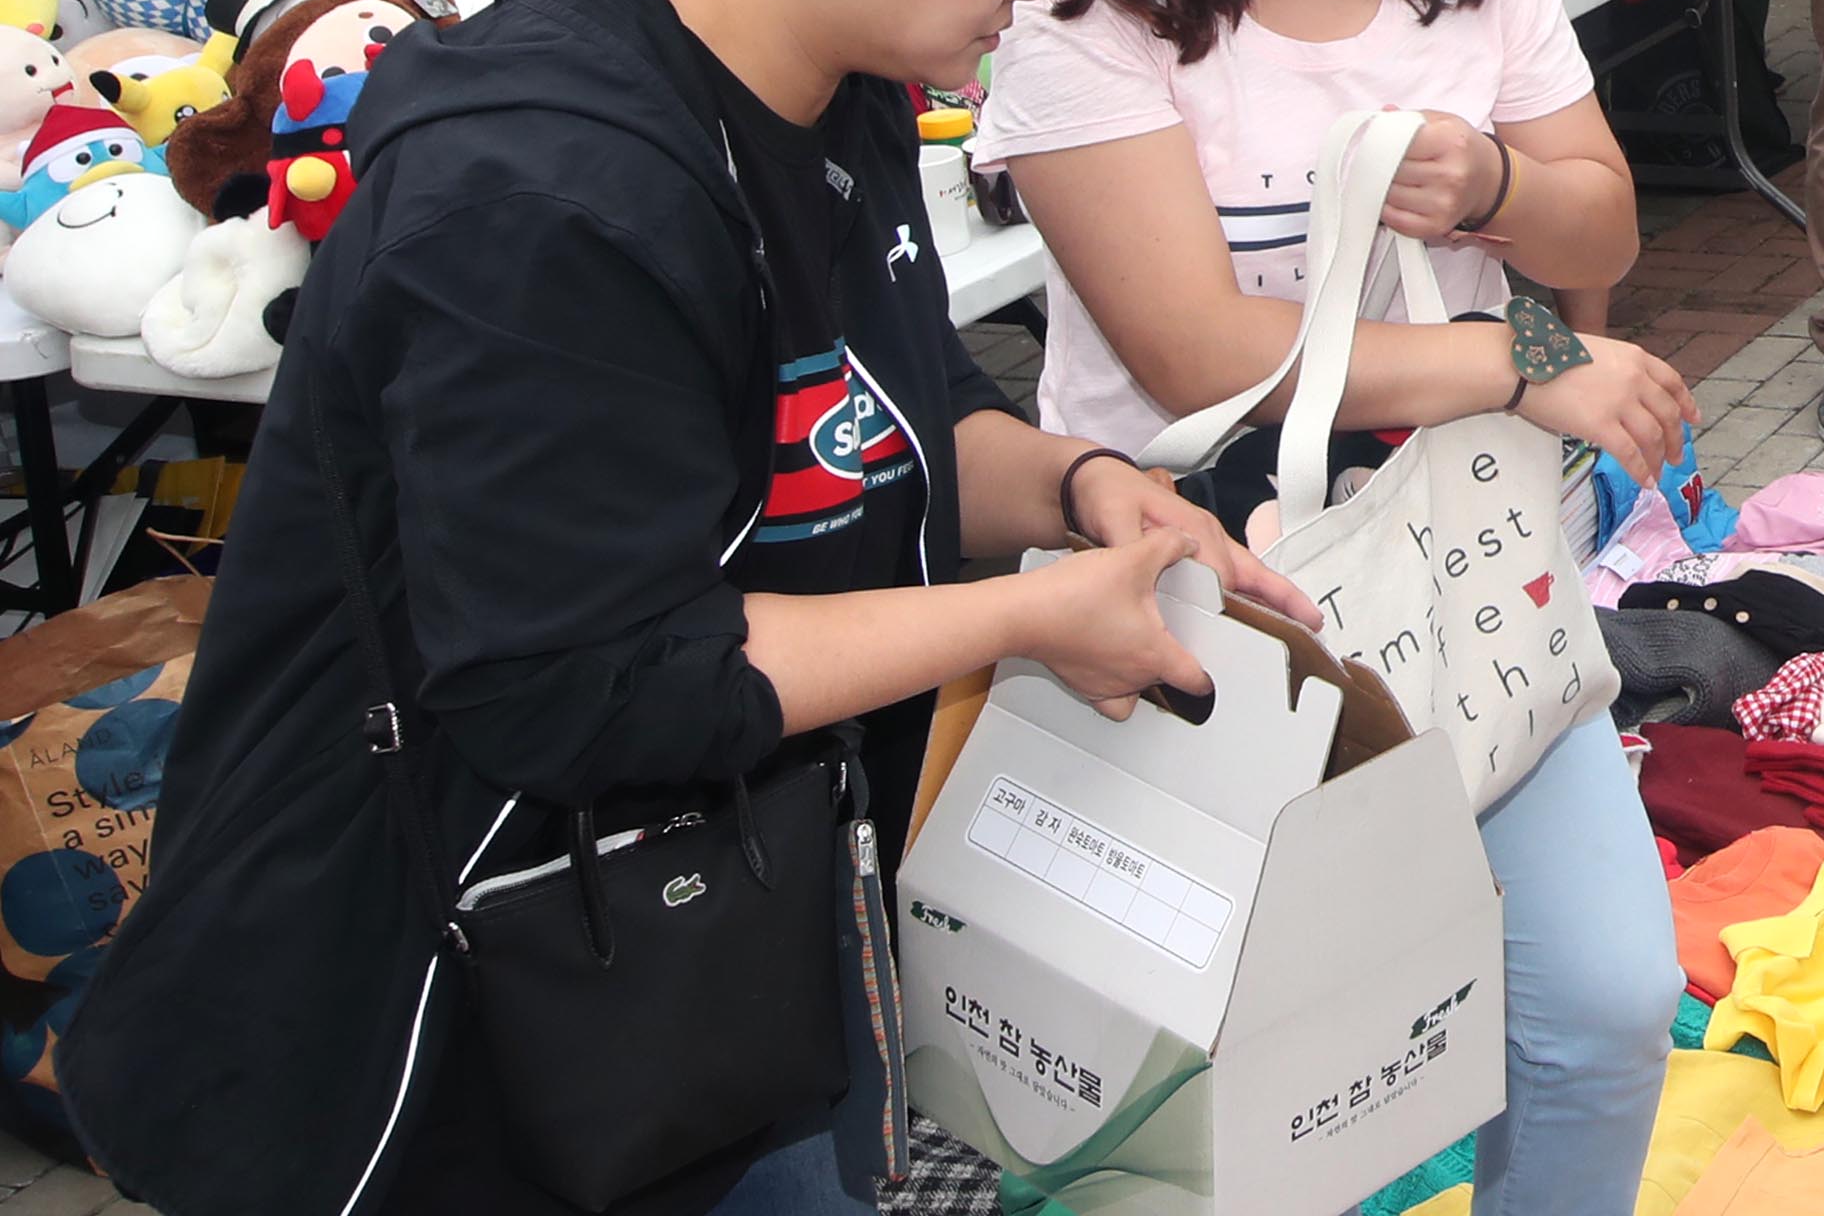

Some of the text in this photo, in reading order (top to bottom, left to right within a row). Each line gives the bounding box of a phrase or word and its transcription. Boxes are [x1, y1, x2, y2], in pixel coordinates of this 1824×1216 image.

[871, 469, 896, 486] YOU
[812, 521, 828, 535] BE
[830, 513, 850, 529] WHO
[62, 829, 84, 850] a
[993, 788, 1027, 815] 고구마
[1066, 826, 1106, 858] 완숙토마토
[1106, 847, 1146, 880] 방울토마토
[73, 839, 149, 881] way
[945, 985, 1102, 1109] 인천 참 농산물
[1291, 1028, 1448, 1143] 인천 참 농산물
